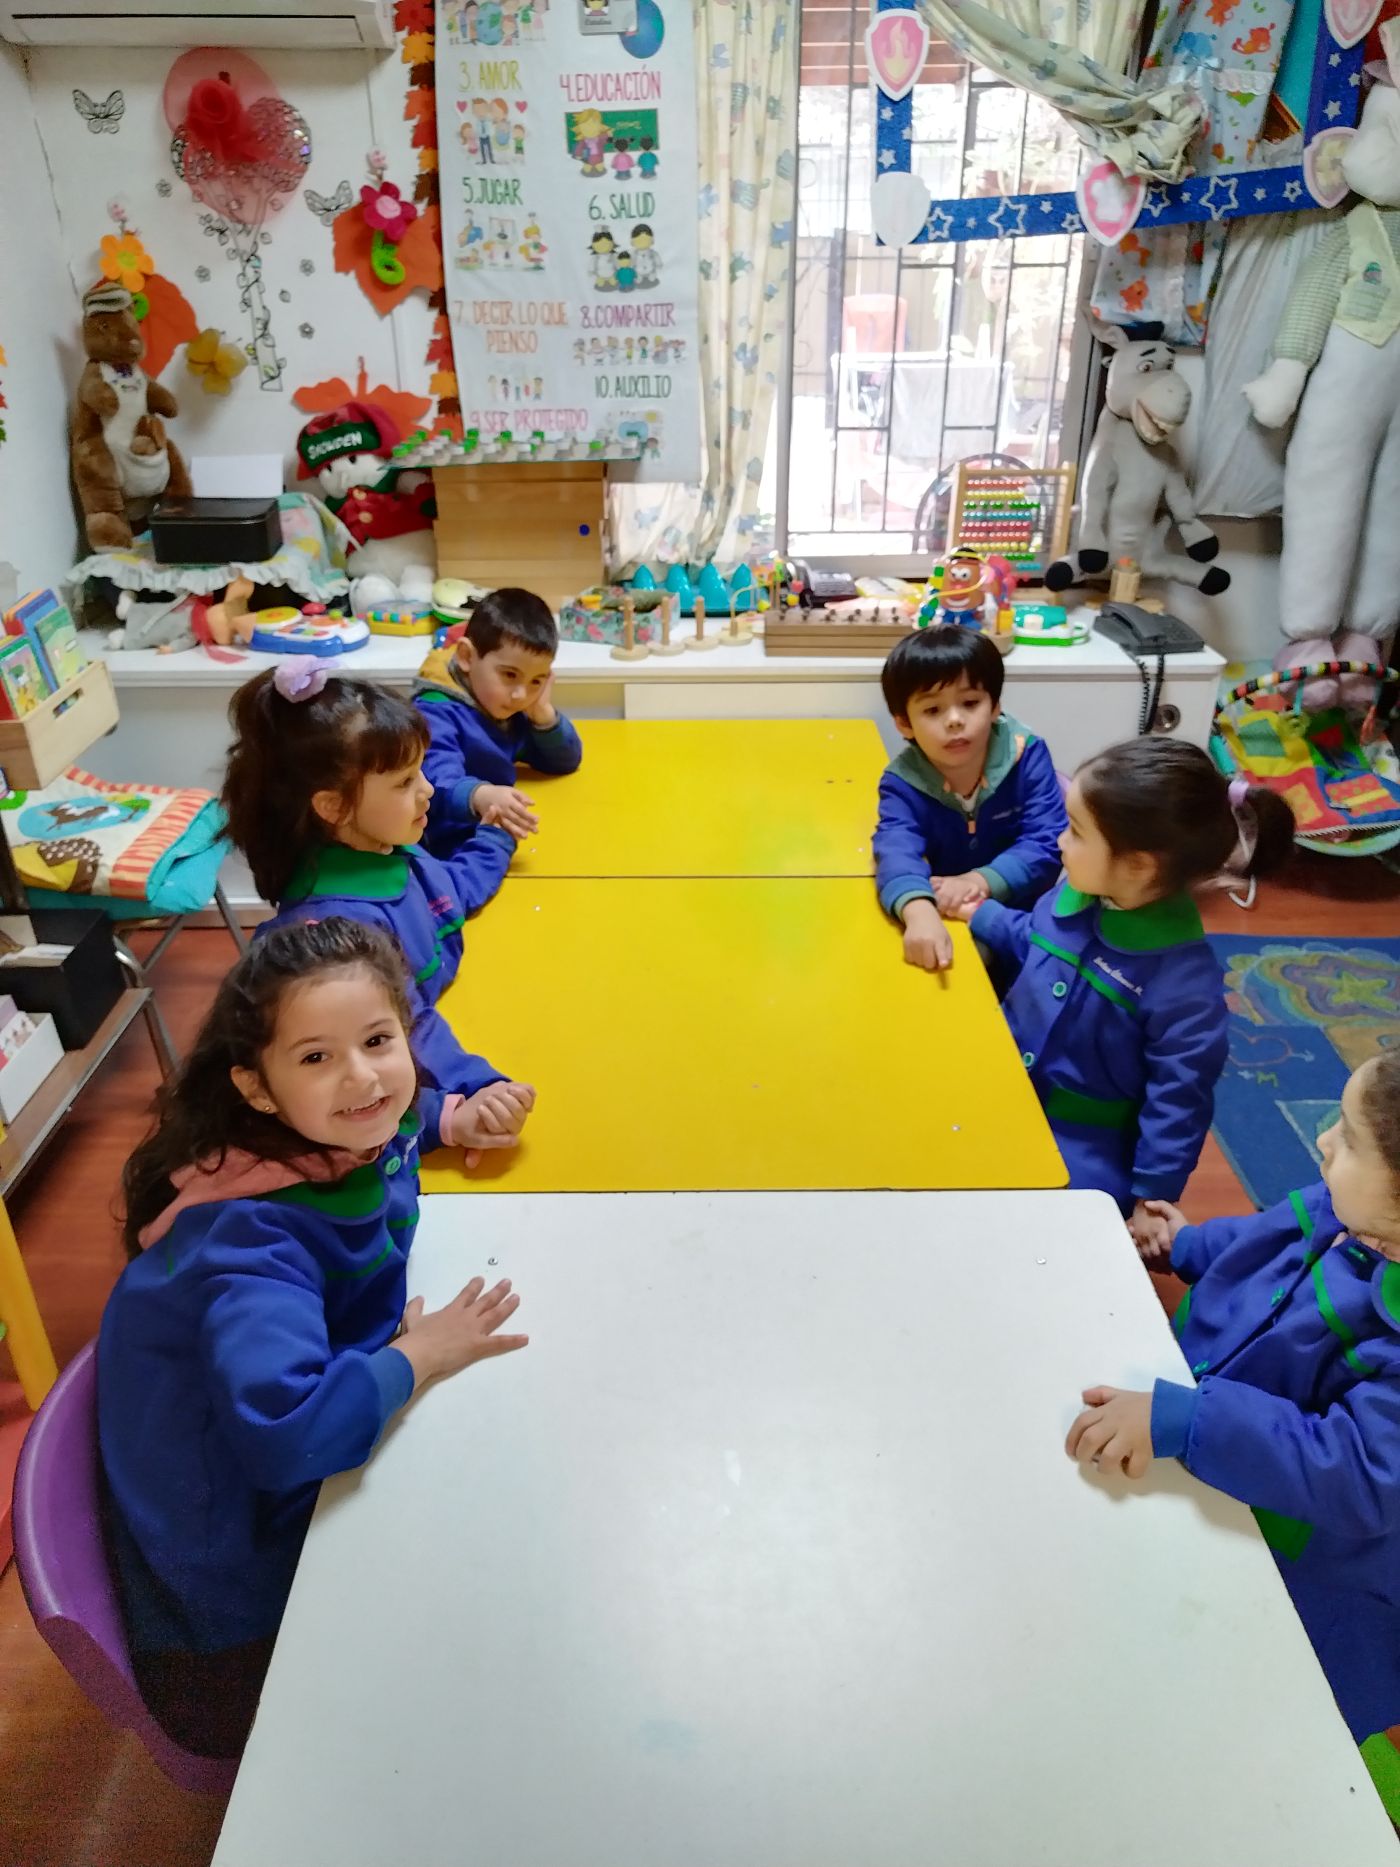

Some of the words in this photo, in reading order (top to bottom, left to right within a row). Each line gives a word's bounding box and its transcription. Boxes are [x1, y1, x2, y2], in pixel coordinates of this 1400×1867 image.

[479, 60, 523, 91] AMOR
[609, 191, 656, 220] SALUD
[472, 301, 516, 325] DECIR
[518, 301, 538, 325] LO
[541, 302, 569, 325] QUE
[486, 330, 538, 354] PIENSO
[514, 408, 589, 431] PROTEGIDO
